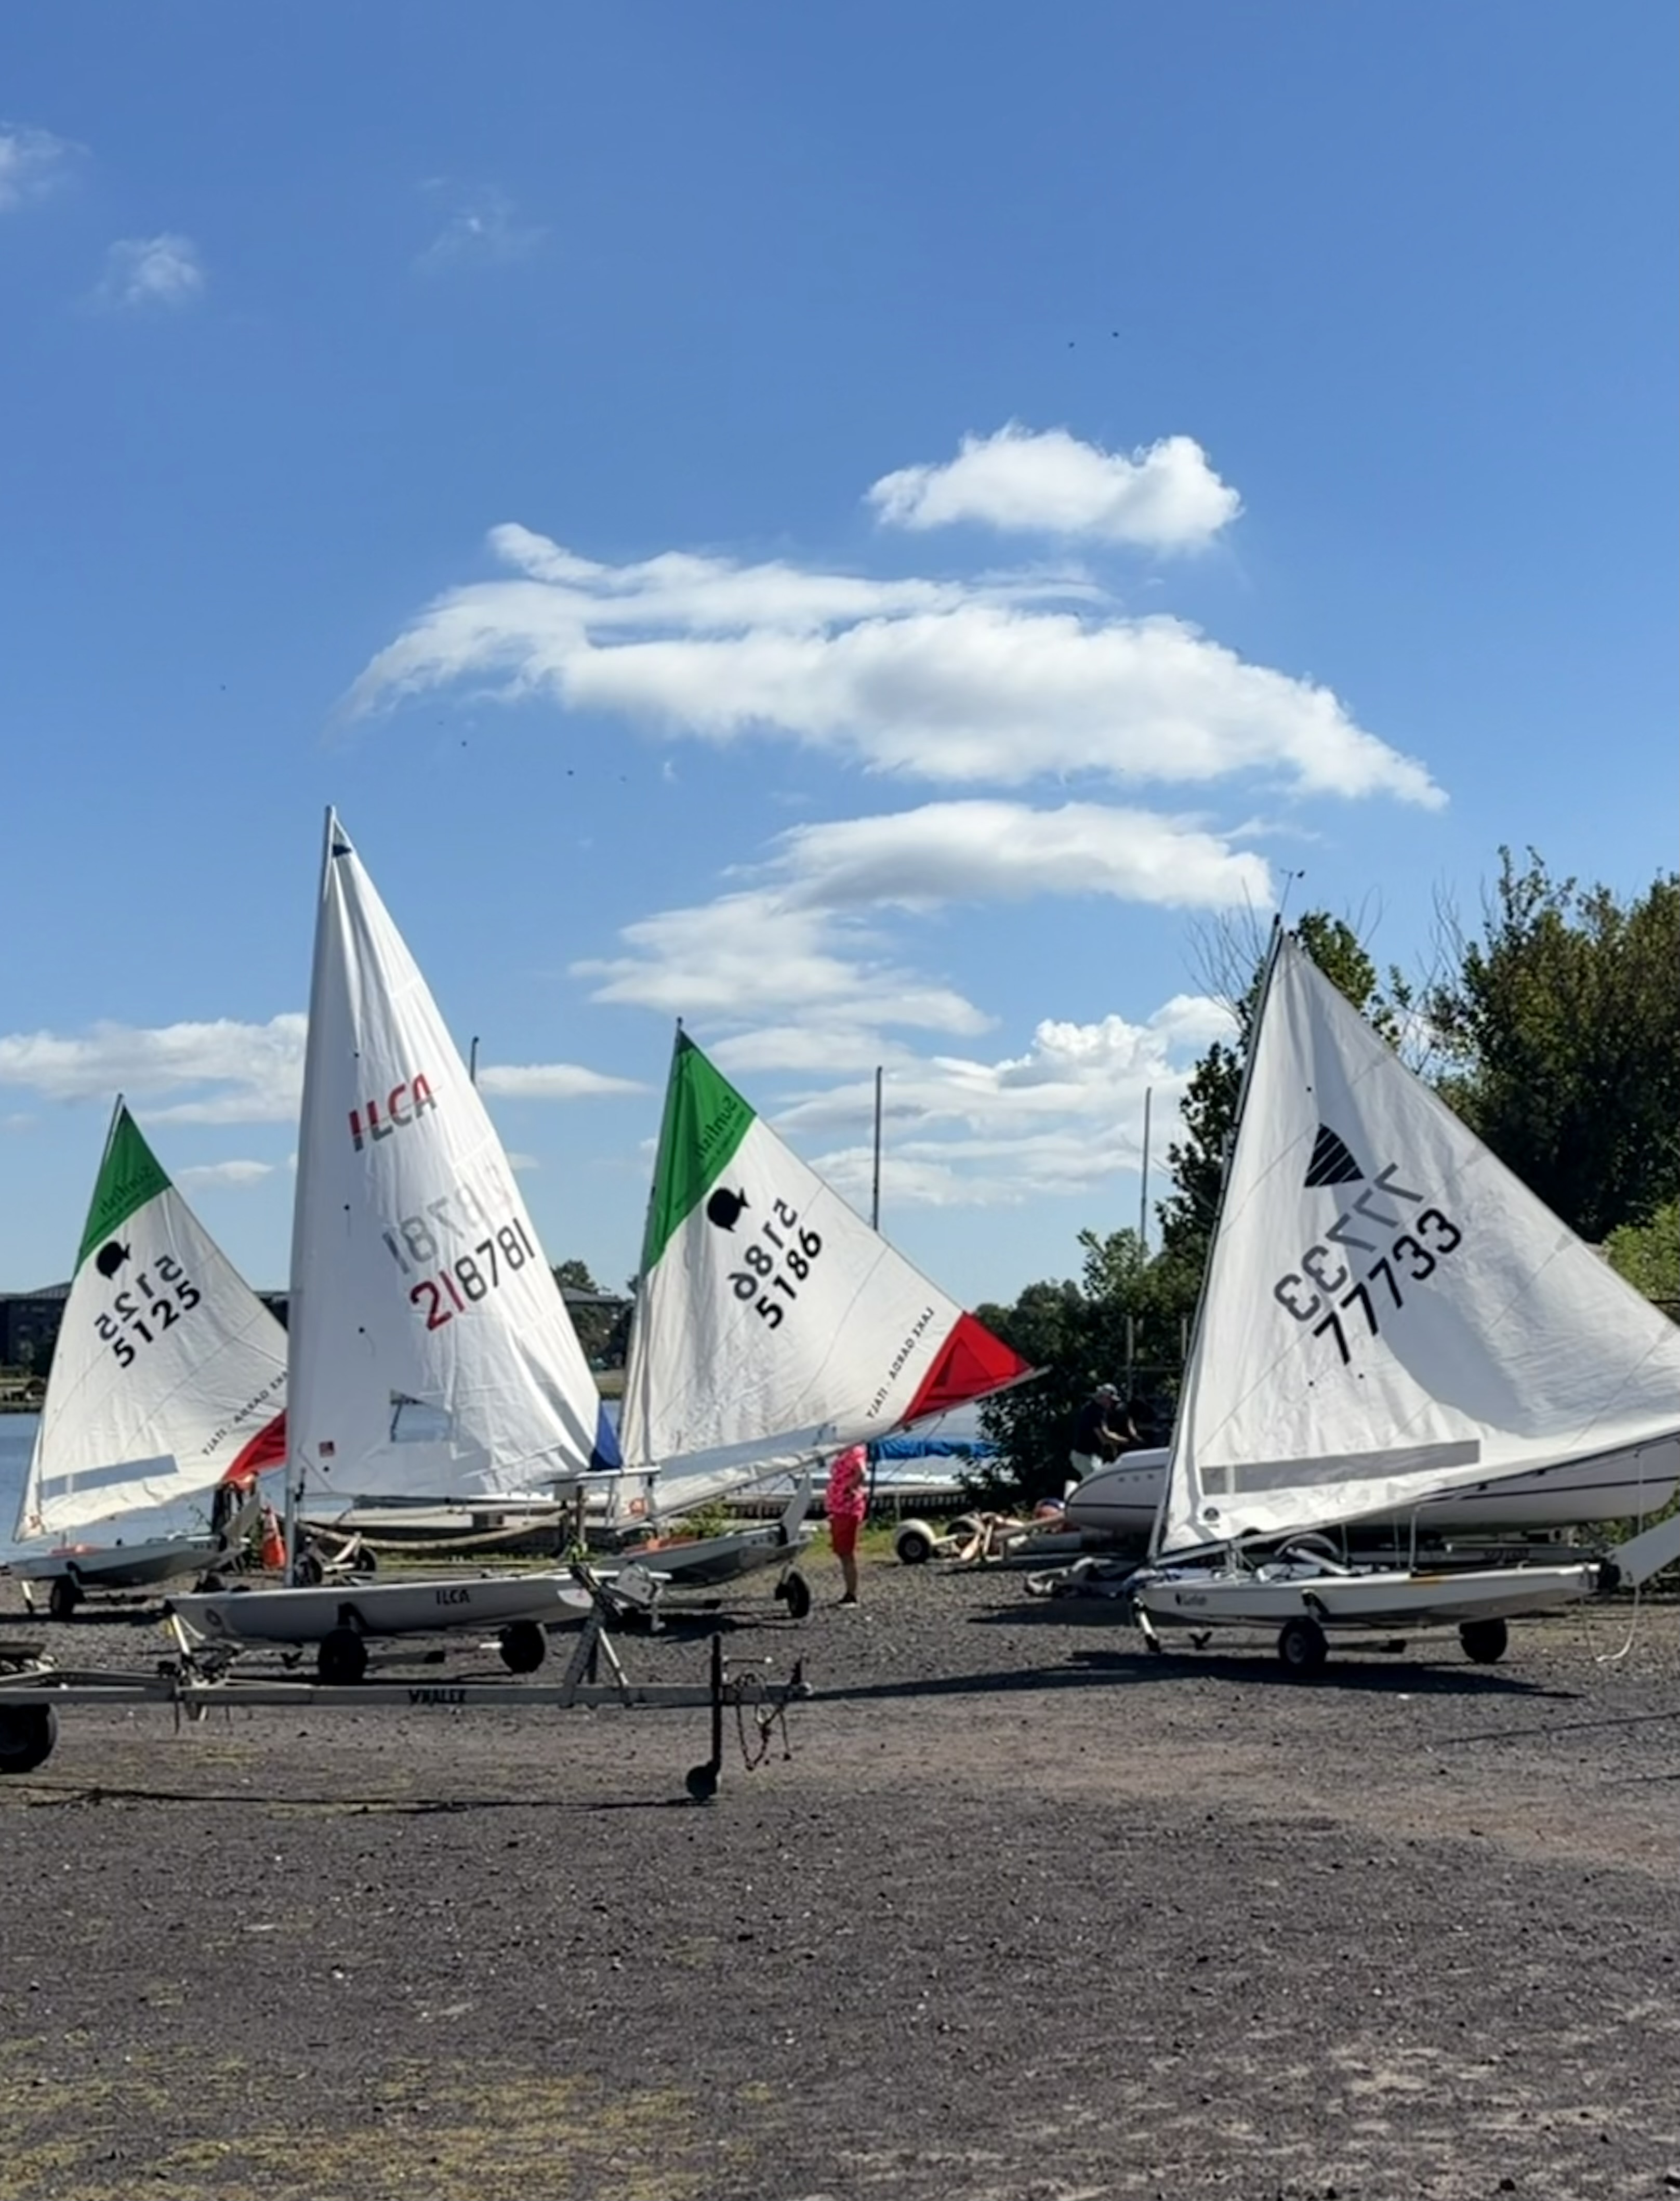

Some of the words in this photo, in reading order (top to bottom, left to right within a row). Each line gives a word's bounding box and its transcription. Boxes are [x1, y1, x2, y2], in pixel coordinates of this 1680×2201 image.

[348, 1073, 437, 1151] ILCA
[411, 1218, 535, 1330] 218781
[756, 1231, 822, 1329] 5186
[1313, 1208, 1462, 1365] 77733
[113, 1280, 201, 1368] 5125
[436, 1589, 470, 1605] ILCA
